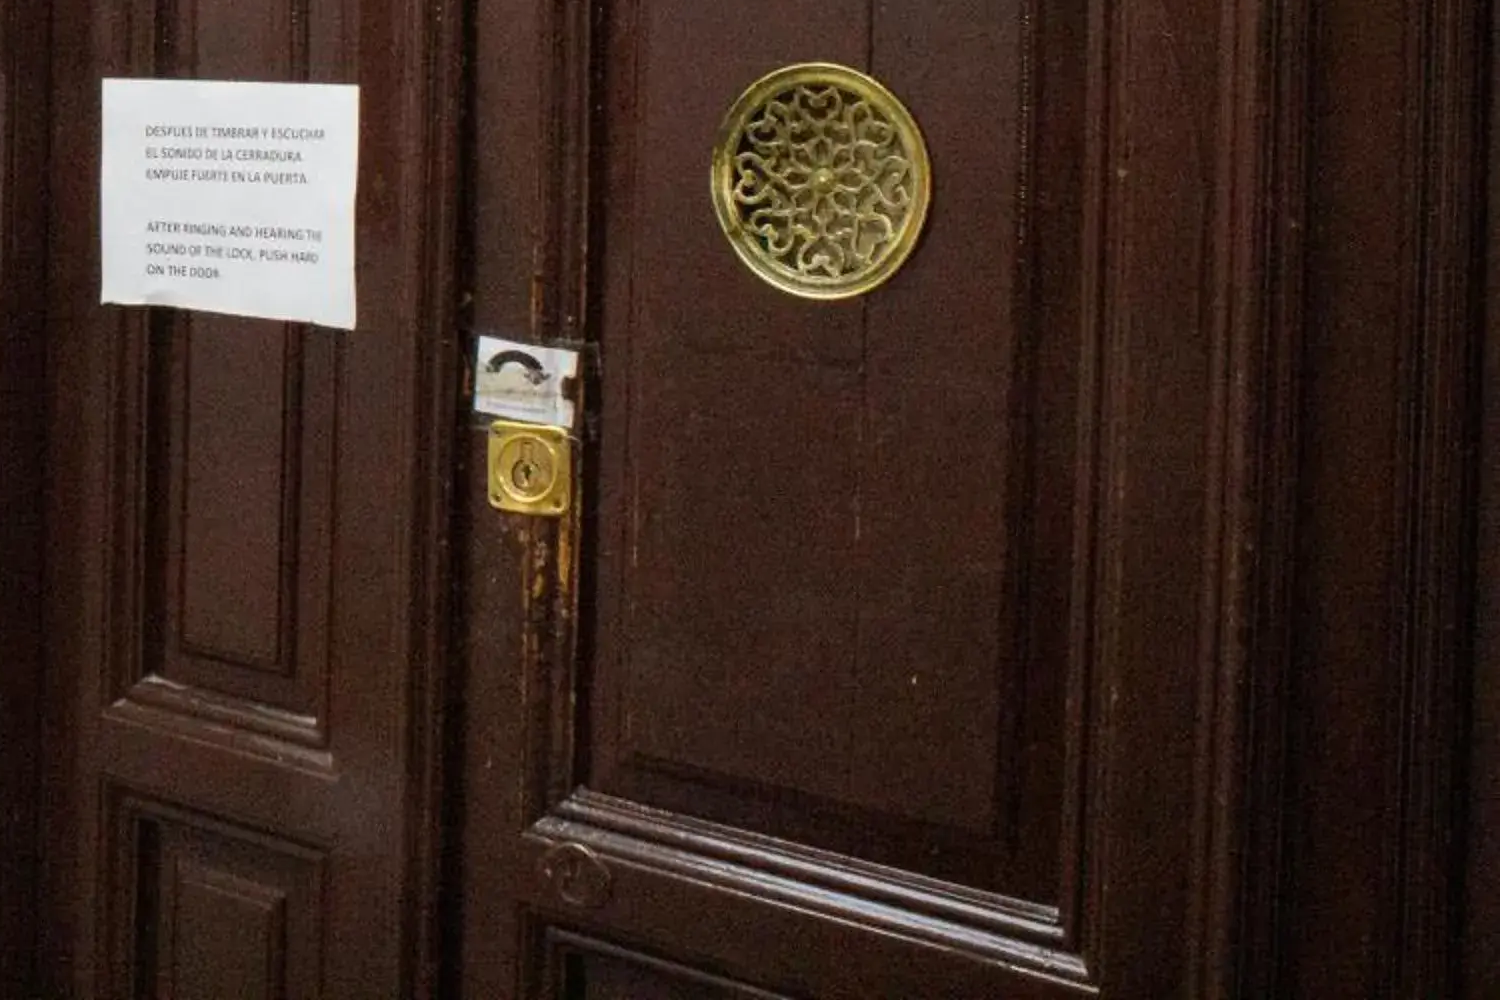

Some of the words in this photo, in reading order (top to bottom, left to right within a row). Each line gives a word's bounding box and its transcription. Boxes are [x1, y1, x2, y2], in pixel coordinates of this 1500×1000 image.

[145, 146, 158, 159] EL
[161, 146, 203, 160] SONIDO
[205, 147, 218, 161] DE
[220, 148, 233, 161] LA
[145, 168, 189, 181] EMPUJE
[231, 170, 245, 183] EN
[247, 171, 261, 183] LA
[146, 220, 181, 233] AFTER
[229, 225, 253, 238] AND
[255, 226, 303, 241] HEARING
[146, 243, 186, 256] SOUND
[188, 245, 202, 257] OF
[205, 245, 223, 259] THE
[259, 249, 288, 262] PUSH
[146, 263, 165, 275] ON
[167, 264, 188, 277] THE
